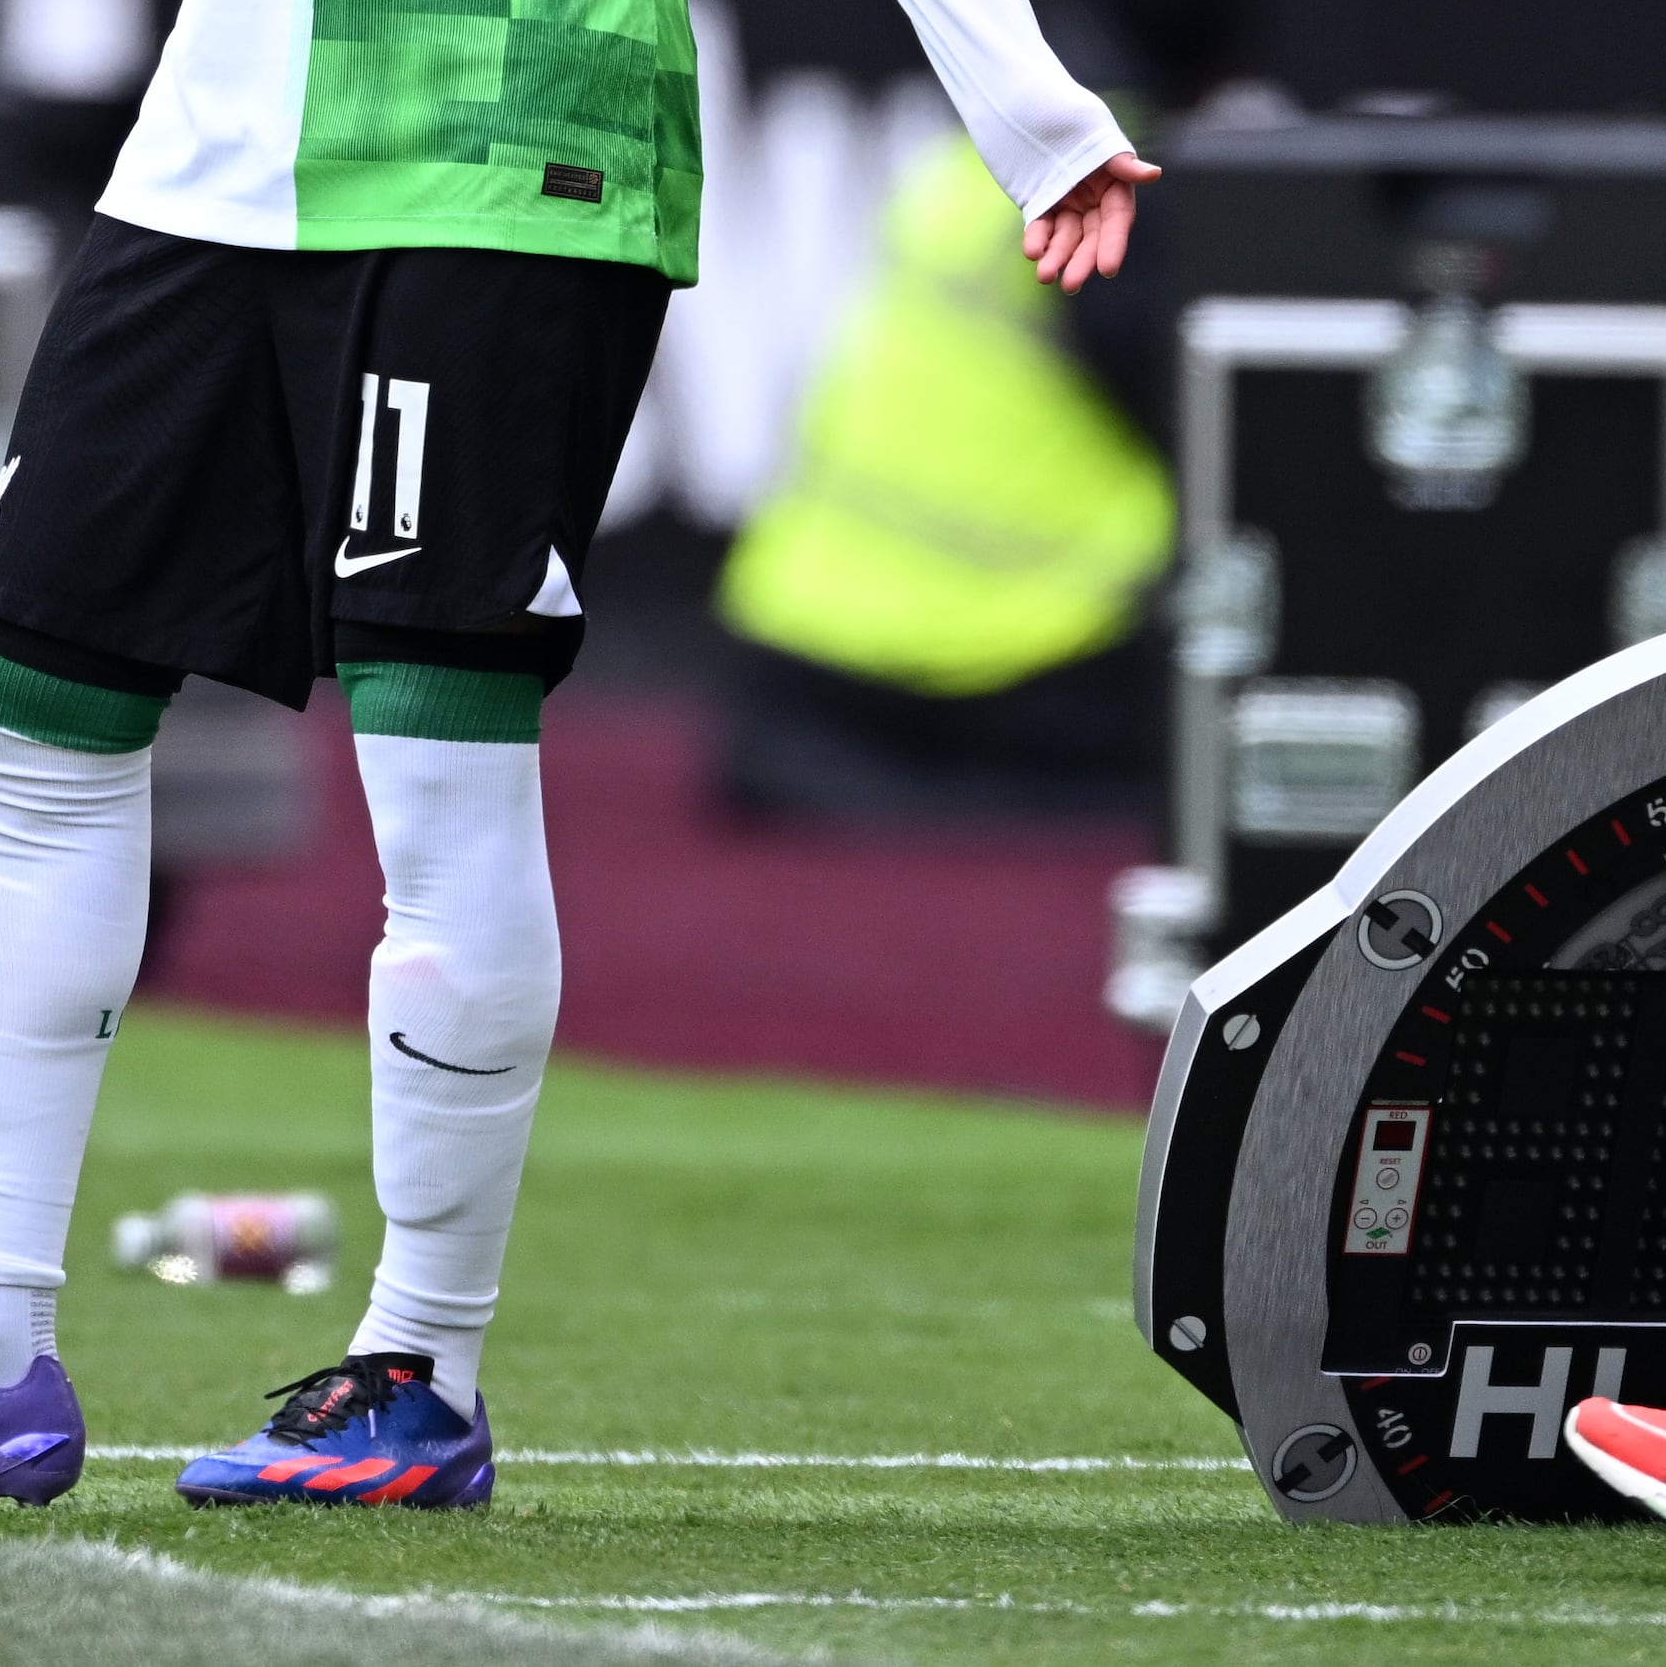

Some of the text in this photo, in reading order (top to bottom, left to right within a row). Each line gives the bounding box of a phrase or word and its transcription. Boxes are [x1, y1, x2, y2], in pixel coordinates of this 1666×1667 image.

[349, 372, 431, 540] 11
[1365, 1241, 1388, 1250] OUT
[1376, 1407, 1413, 1449] 40
